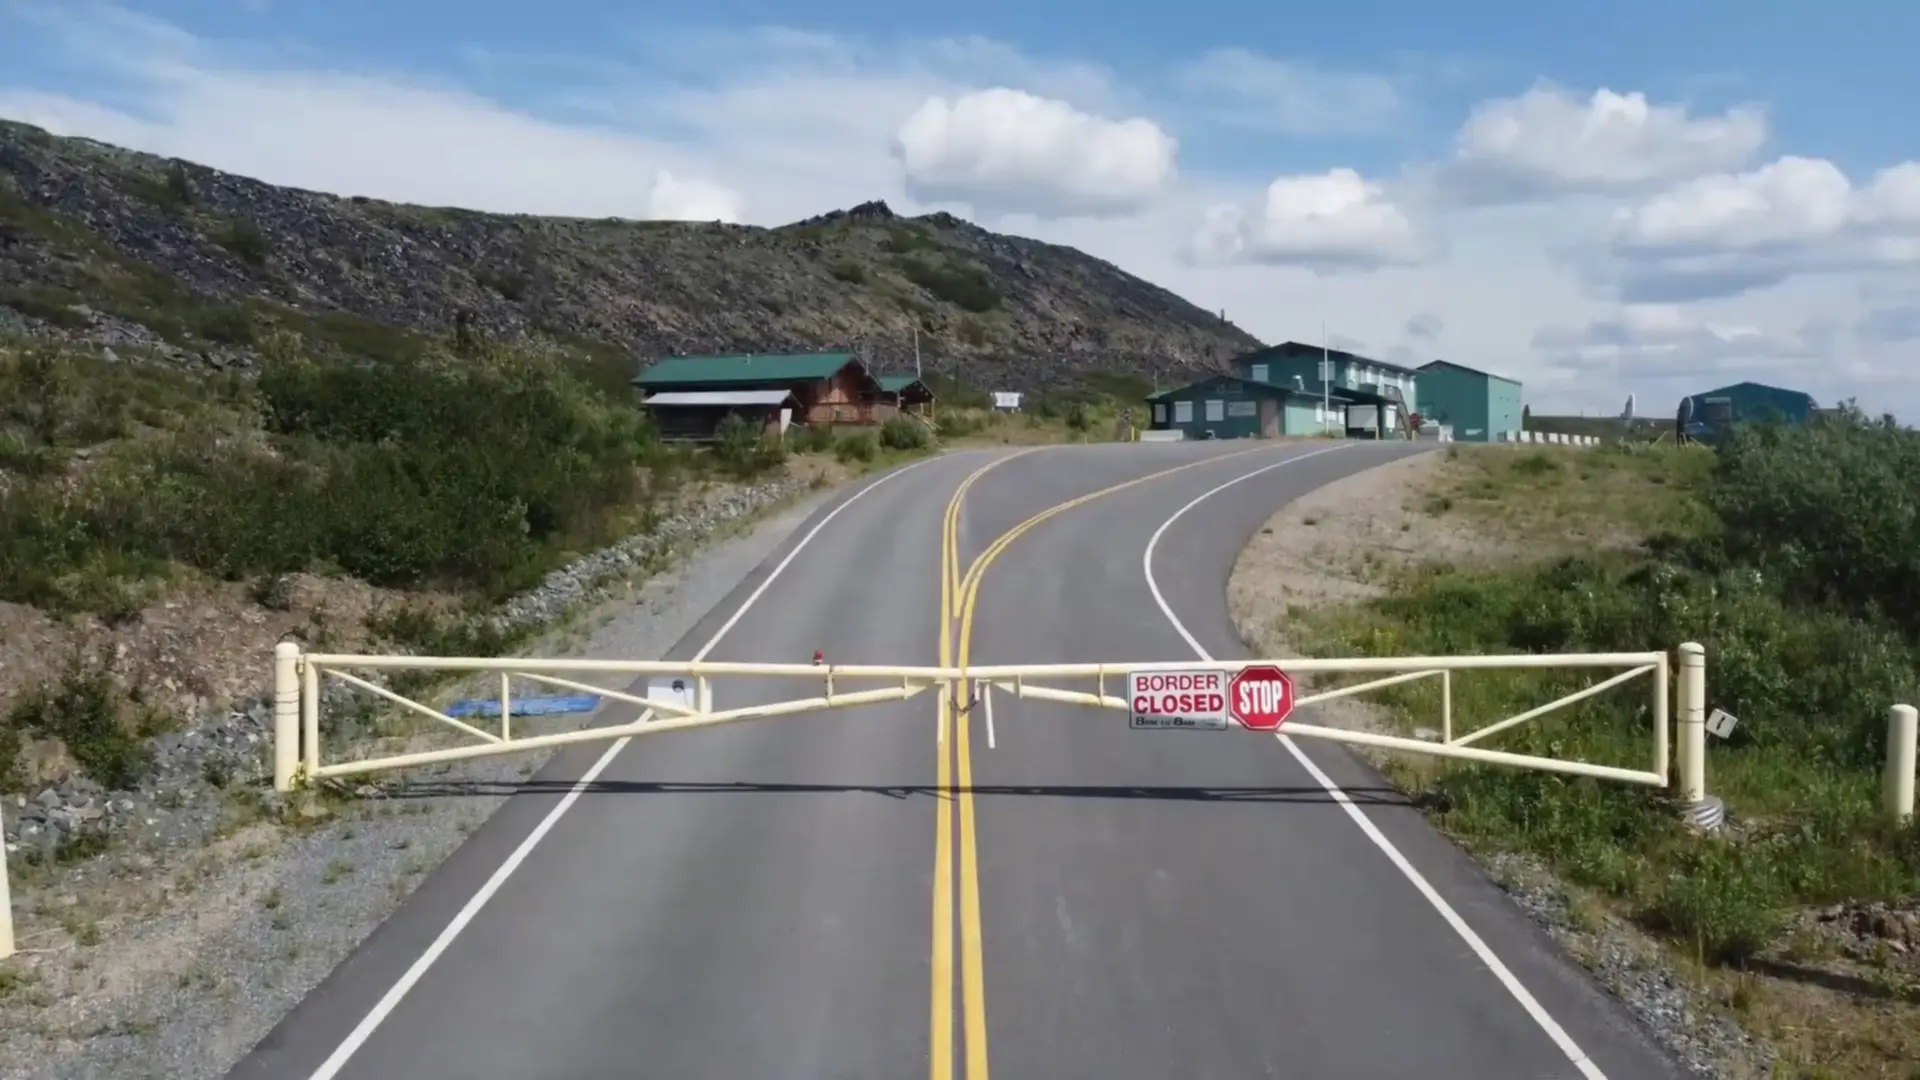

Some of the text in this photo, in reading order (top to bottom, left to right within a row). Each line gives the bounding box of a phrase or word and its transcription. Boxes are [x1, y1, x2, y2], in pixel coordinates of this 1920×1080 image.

[1136, 675, 1218, 691] BORDER
[1133, 694, 1223, 713] CLOSED
[1239, 680, 1283, 714] STOP
